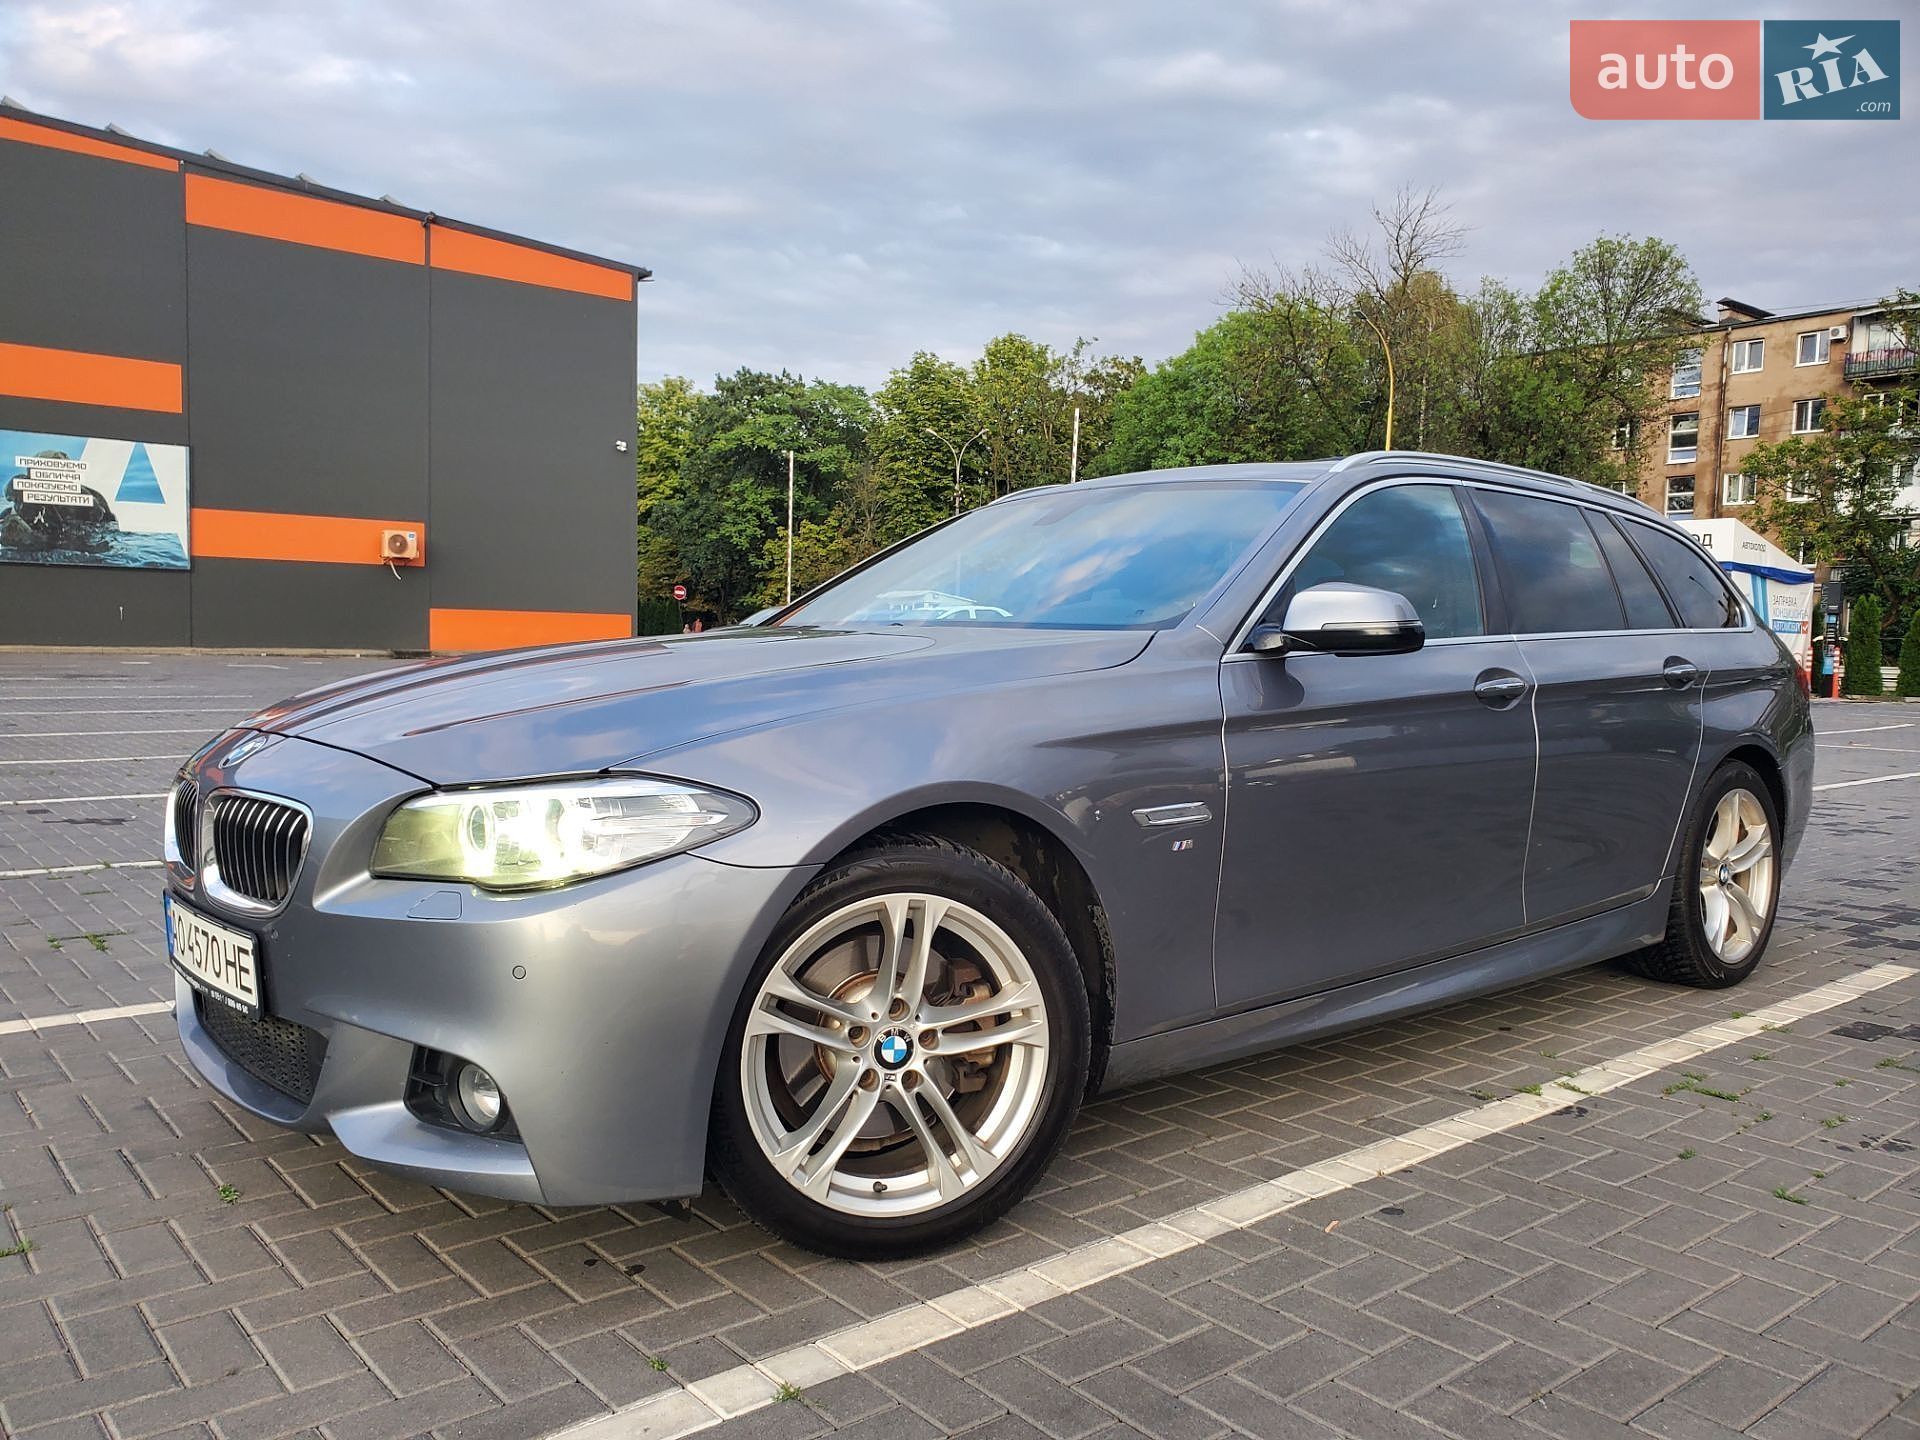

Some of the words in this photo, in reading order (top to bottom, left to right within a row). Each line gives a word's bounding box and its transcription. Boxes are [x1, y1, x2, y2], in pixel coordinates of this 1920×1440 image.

[18, 457, 88, 471] ПРИХОВУЄМО
[34, 470, 82, 481] ОБЛИЧЧЯ
[16, 481, 78, 492] ПОКАЗУЄМО
[26, 493, 91, 505] РЕЗУЛЬТАТИ
[188, 922, 222, 978] 4570
[223, 940, 253, 994] HE
[878, 1028, 912, 1043] BMW
